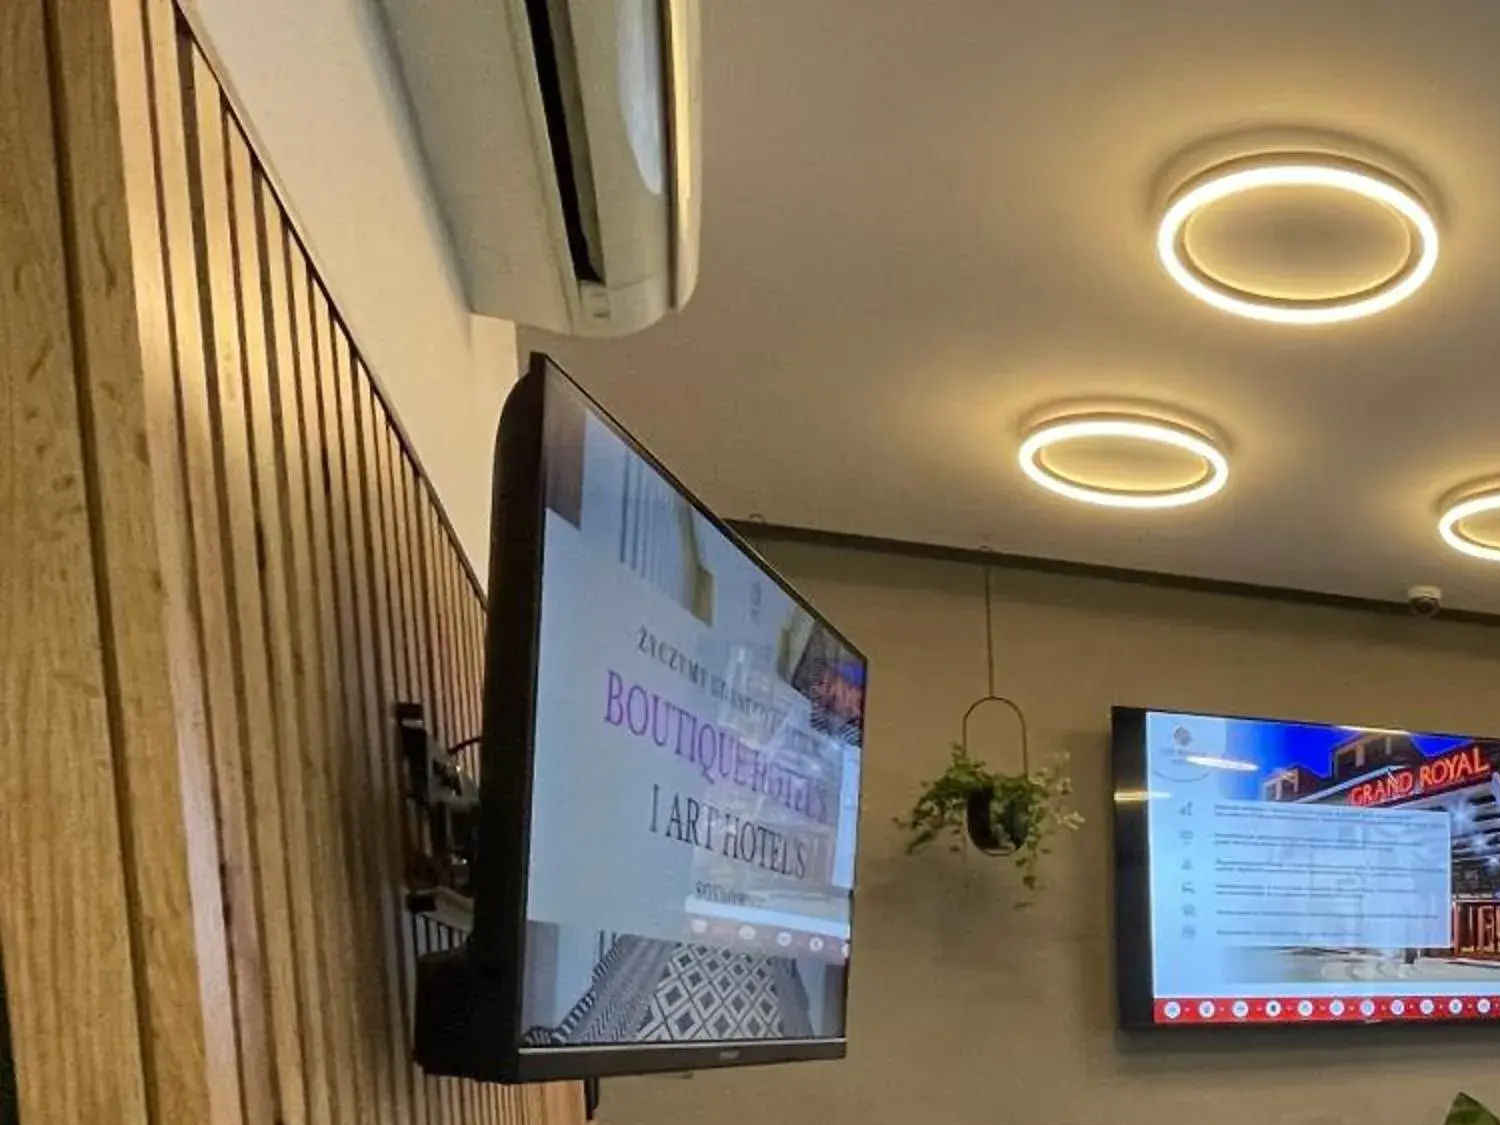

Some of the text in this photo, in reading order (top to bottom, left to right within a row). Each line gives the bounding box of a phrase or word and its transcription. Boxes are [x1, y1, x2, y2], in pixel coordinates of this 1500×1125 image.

[603, 669, 747, 788] BOUTIQUE
[1351, 746, 1490, 806] GRAND ROYAL
[649, 783, 807, 880] I ART HOTELS
